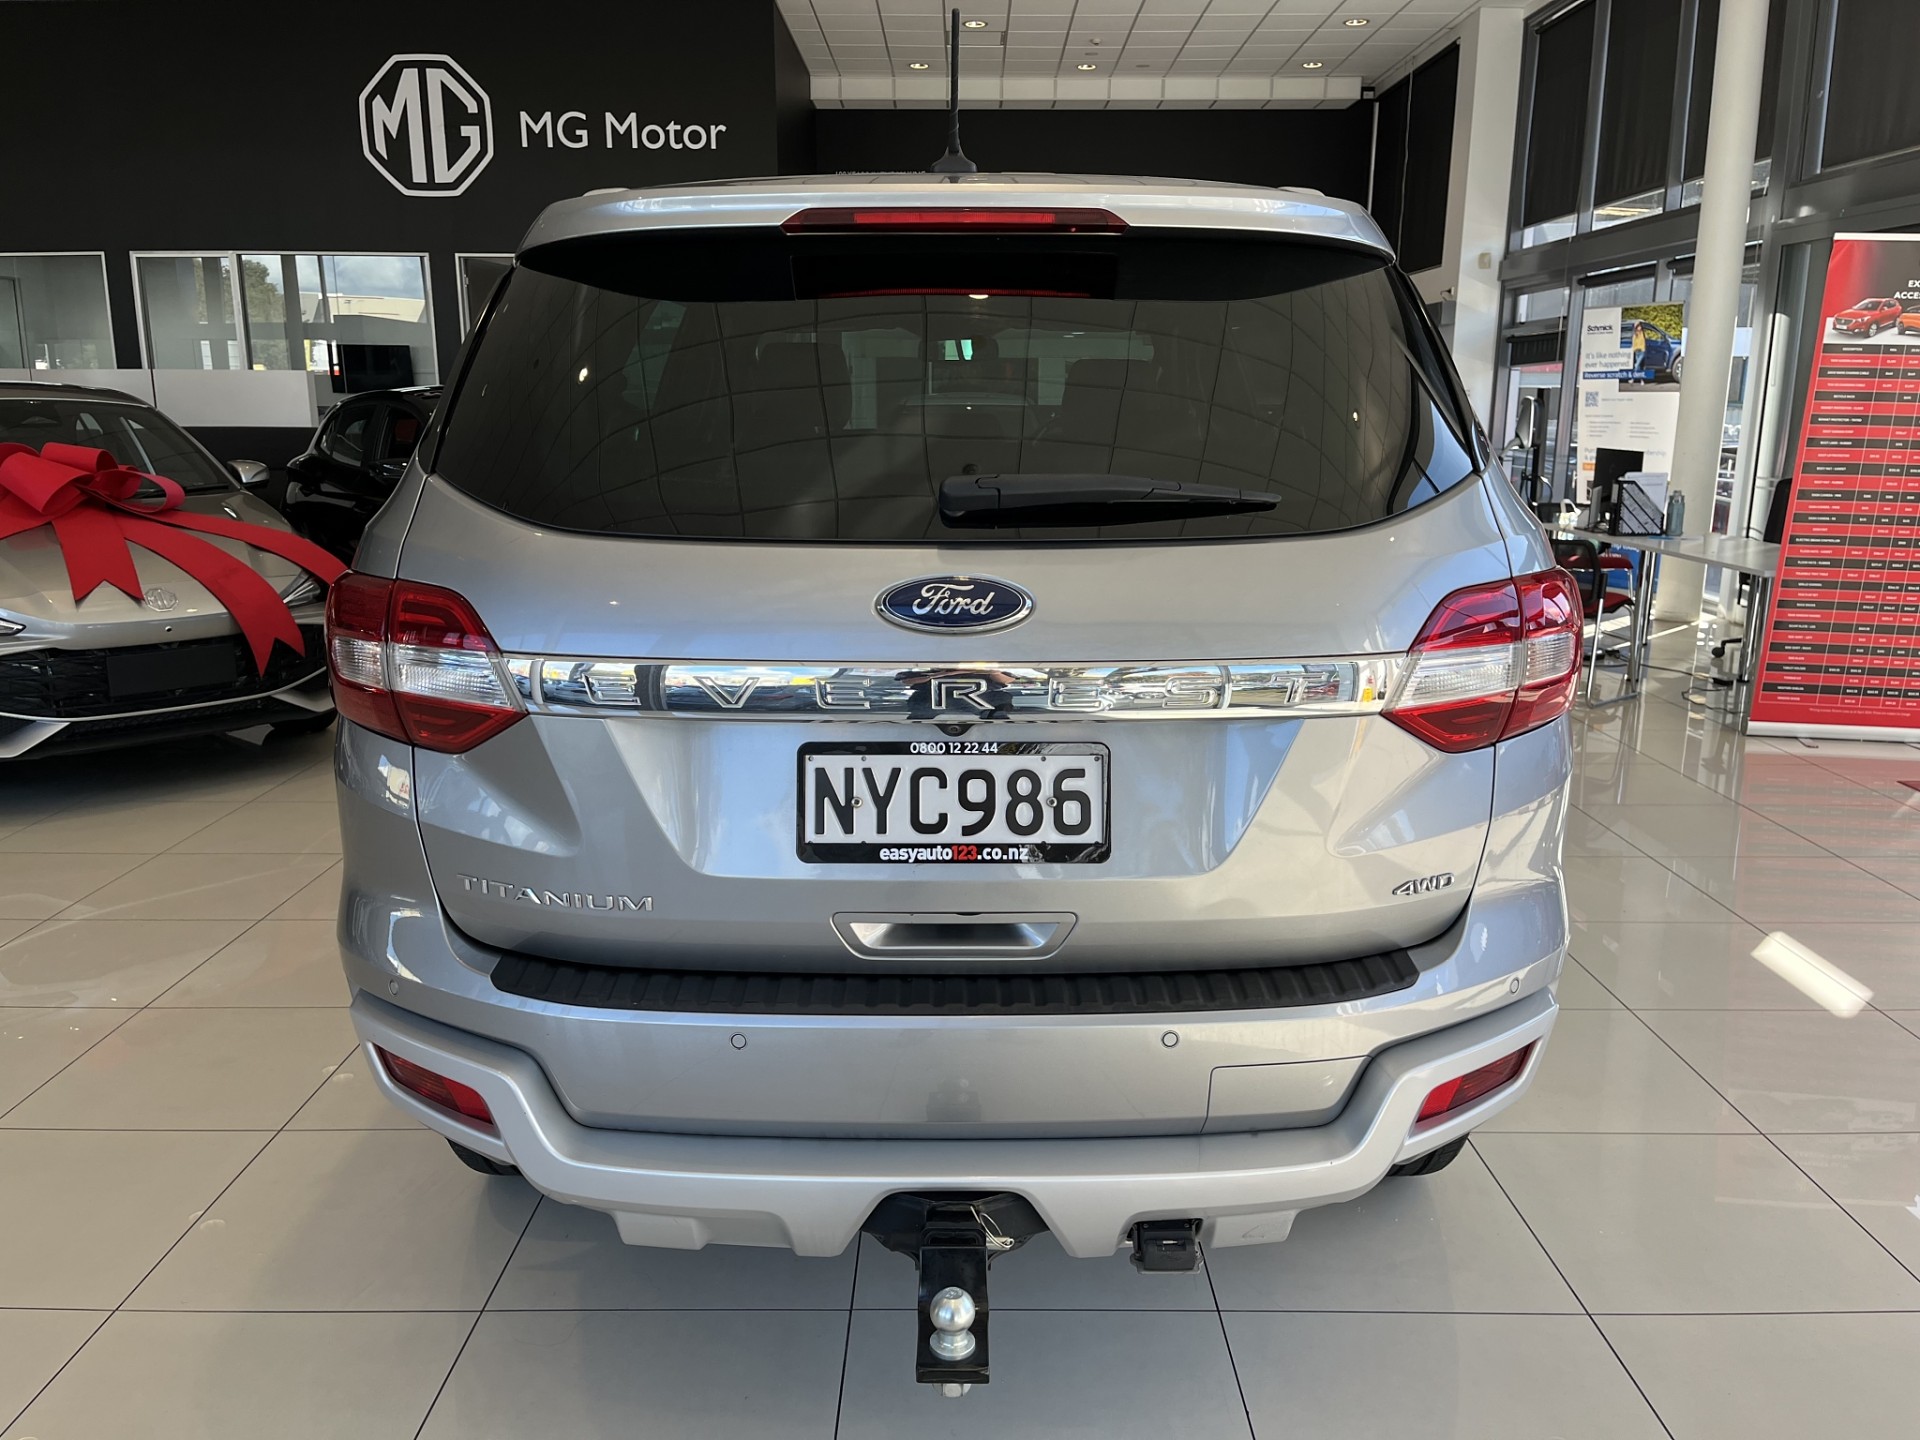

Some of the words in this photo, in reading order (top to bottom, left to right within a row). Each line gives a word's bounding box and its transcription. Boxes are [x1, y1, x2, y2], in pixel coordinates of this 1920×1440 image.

[371, 67, 482, 184] MG
[518, 110, 590, 150] MG
[604, 111, 728, 151] Motor
[1893, 290, 1920, 300] ACCE
[1587, 324, 1613, 332] Schmick
[1585, 352, 1595, 360] It's
[1596, 352, 1607, 360] like
[1608, 351, 1632, 361] nothing
[1607, 371, 1628, 379] scratch
[911, 583, 996, 616] Ford
[581, 671, 1327, 711] EVEREST
[909, 741, 945, 755] 0800
[949, 741, 963, 755] 12
[963, 741, 980, 755] 22
[981, 741, 999, 755] 44
[814, 767, 1093, 837] NYC986
[879, 844, 1030, 864] easyauto123.co.nz
[456, 873, 655, 912] TITANIUM
[1391, 872, 1456, 896] 4WD
